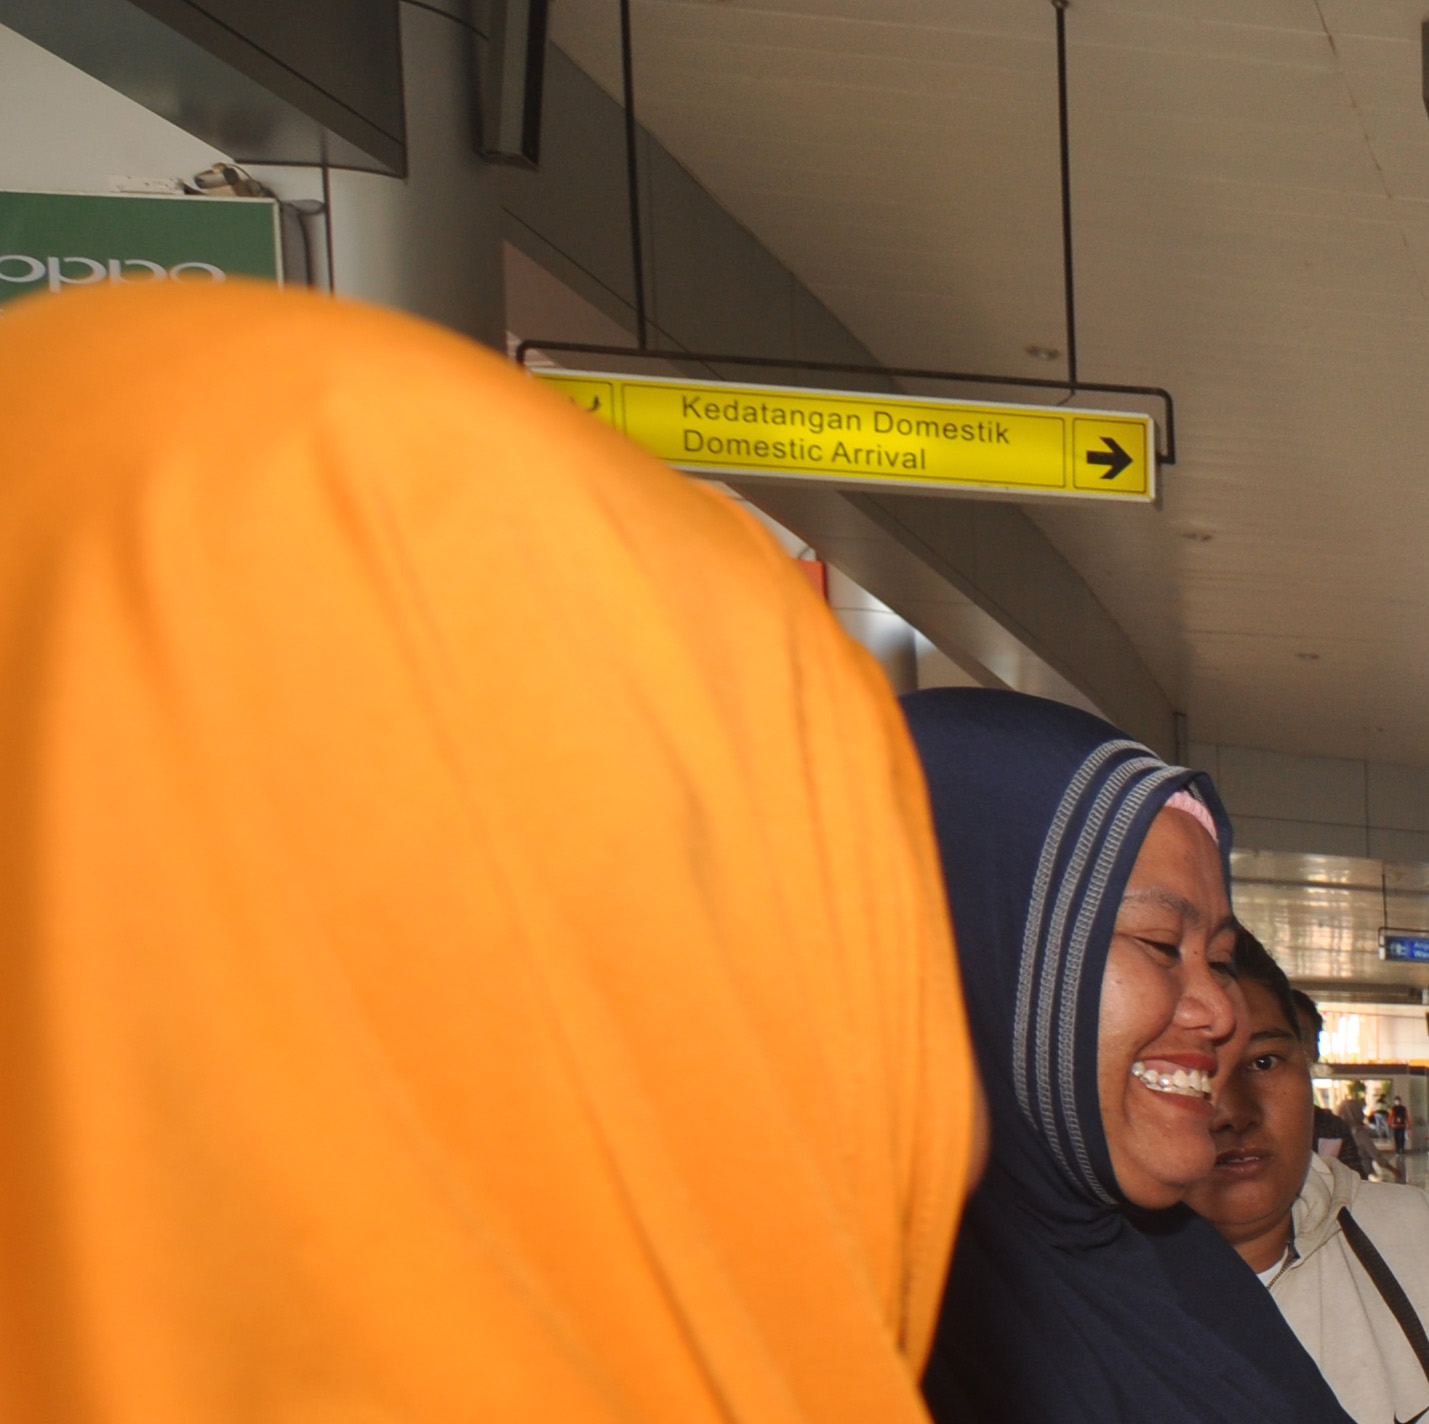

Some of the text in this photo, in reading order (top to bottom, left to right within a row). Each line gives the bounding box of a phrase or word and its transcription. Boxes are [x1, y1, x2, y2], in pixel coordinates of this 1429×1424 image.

[681, 395, 1011, 445] Kedatangan Domestik
[683, 429, 926, 470] Domestic Arrival
